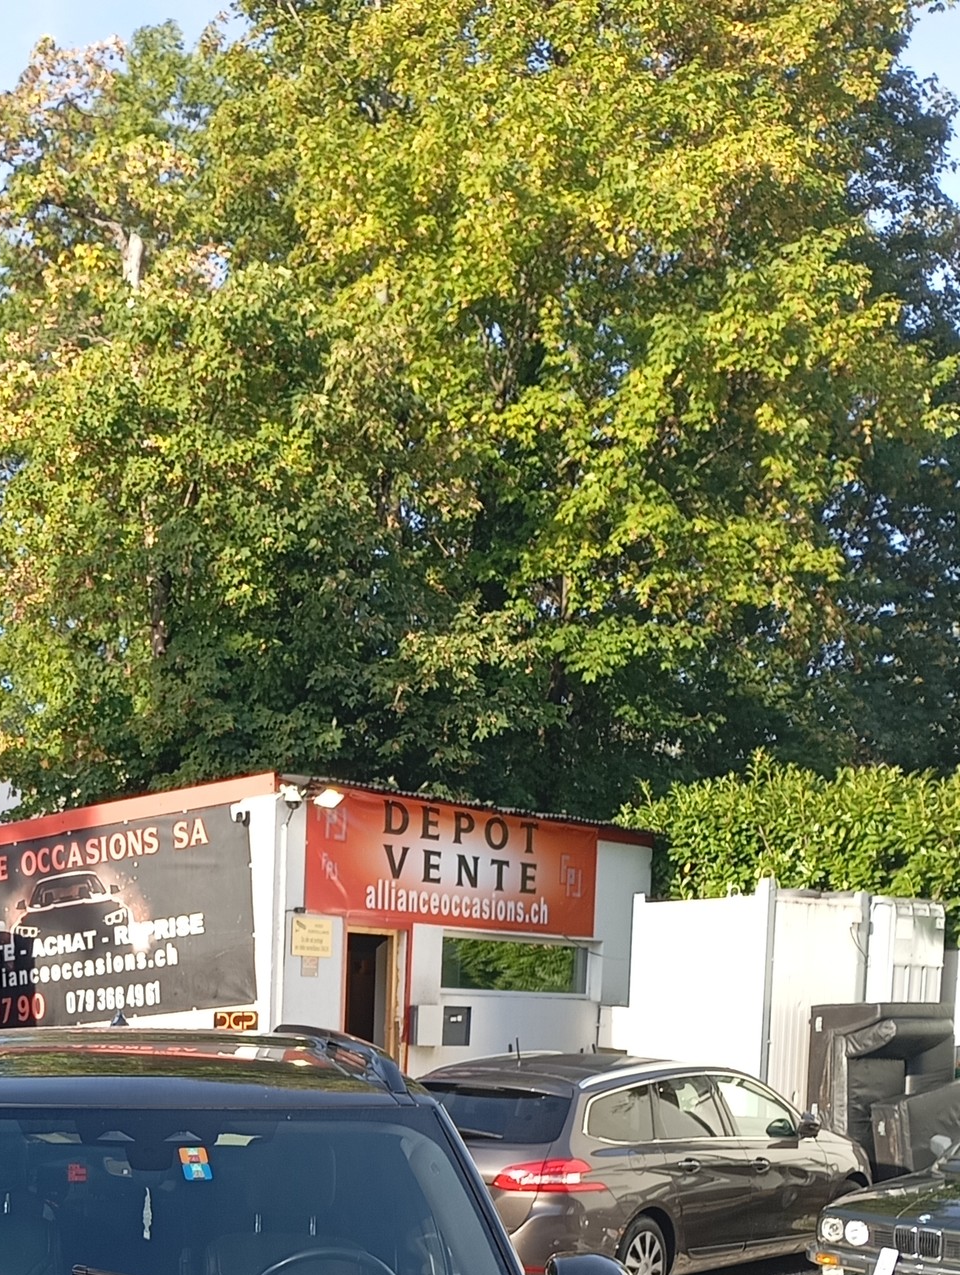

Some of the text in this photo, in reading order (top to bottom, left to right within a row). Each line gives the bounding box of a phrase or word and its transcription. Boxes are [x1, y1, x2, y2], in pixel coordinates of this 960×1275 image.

[21, 827, 159, 876] OCCASIONS
[173, 818, 209, 849] SA
[383, 844, 538, 895] VENTE
[366, 879, 548, 925] allianceoccasions.ch
[32, 930, 97, 958] ACHAT
[114, 912, 205, 945] RPRISE
[17, 993, 45, 1021] 90
